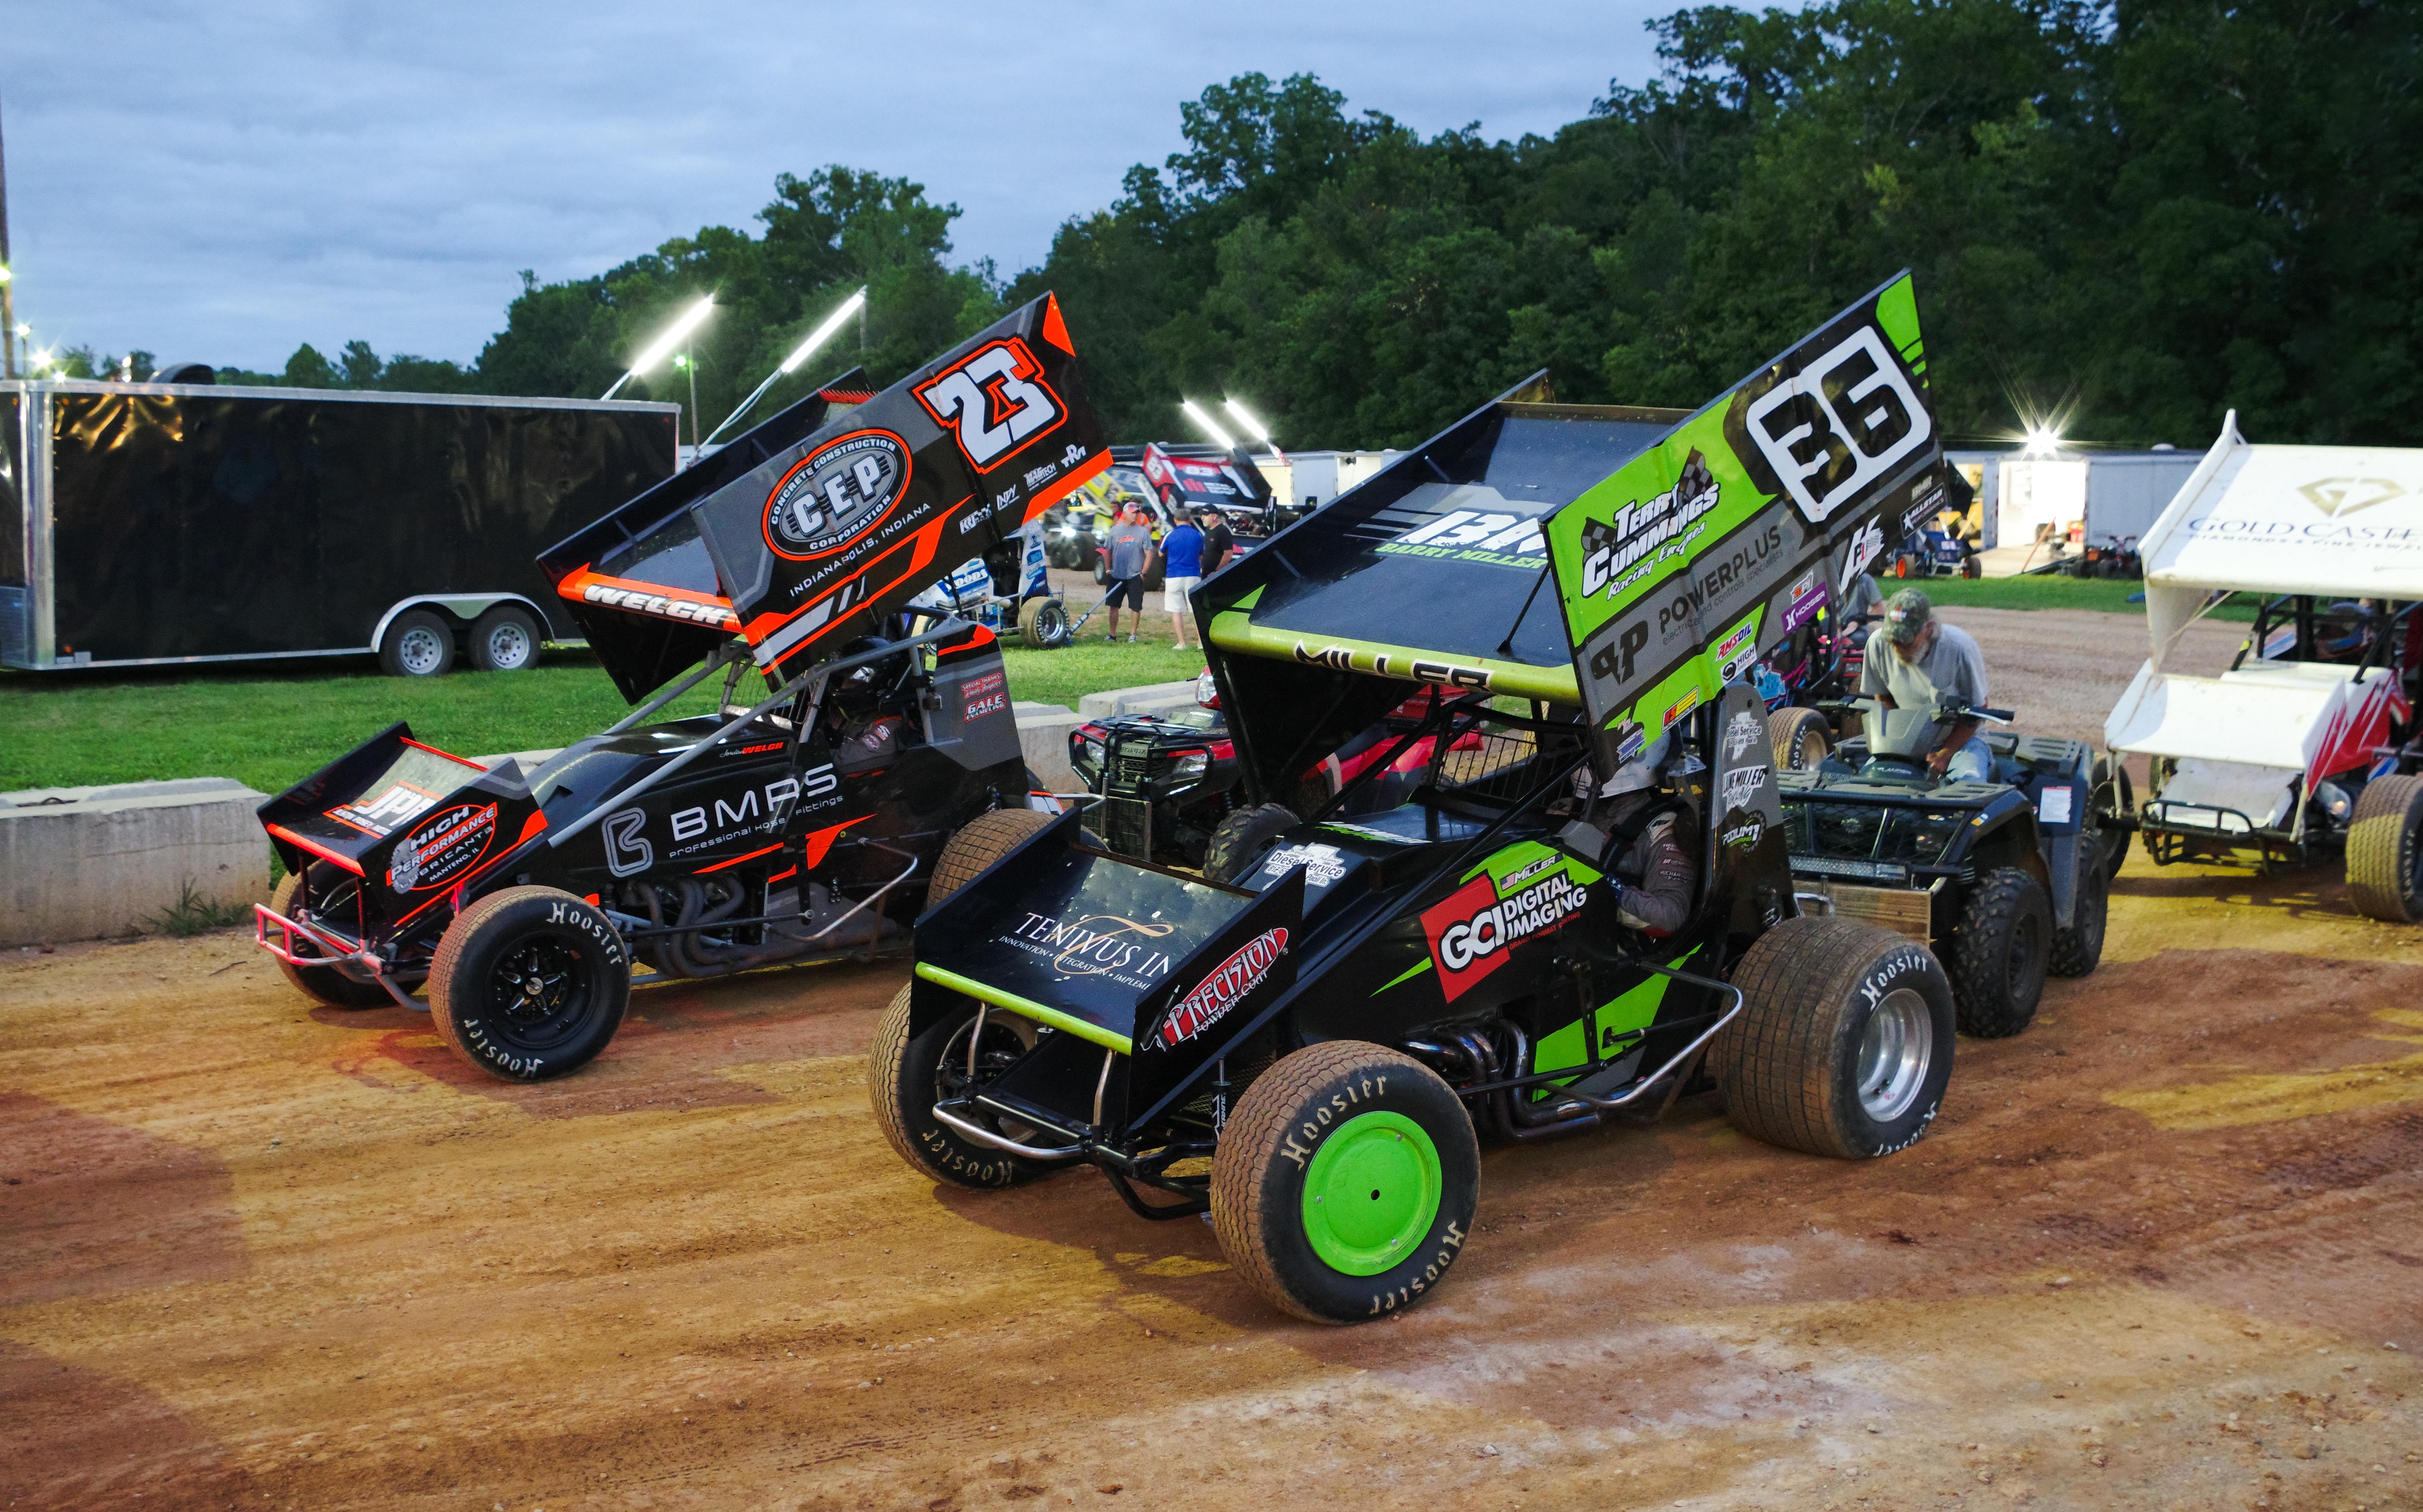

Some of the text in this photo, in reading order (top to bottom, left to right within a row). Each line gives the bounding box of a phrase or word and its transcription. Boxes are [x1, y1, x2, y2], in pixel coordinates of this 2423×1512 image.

[1752, 336, 1921, 513] 36
[771, 438, 896, 525] CONCRETE CONSTRUCTION
[792, 455, 882, 534] CEP
[809, 495, 891, 551] CORPORATION
[1615, 482, 1680, 543] TERRY
[2188, 517, 2294, 536] GOLD
[789, 539, 879, 597] INDIANAPOLIS,
[881, 503, 931, 538] INDIANA
[1373, 543, 1549, 569] BARRY MILLER
[1582, 483, 1720, 597] CUMMINGS
[1607, 521, 1706, 601] Racing Engines
[584, 585, 727, 624] WELCH
[1659, 525, 1781, 634] POWERPLUS
[1714, 579, 1744, 608] controls
[1795, 590, 1825, 618] HOOSIER
[1717, 623, 1752, 661] AMSOIL
[1737, 645, 1755, 667] HIGH
[962, 674, 1000, 689] SPECIAL THANKS
[968, 694, 1002, 714] GALE
[966, 703, 1004, 720] ENAMELING
[1740, 726, 1762, 736] Service
[742, 742, 784, 754] WELCH
[391, 806, 494, 880] PERFORMANCE
[410, 806, 470, 851] HIGH
[399, 825, 494, 888] LUBRICANTS
[1271, 852, 1343, 877] Diesel Service
[1306, 874, 1321, 883] Paoli
[1514, 856, 1556, 884] MILLER
[1503, 874, 1572, 921] DIGITAL
[1508, 887, 1587, 940] IMAGING
[546, 902, 623, 965] Hoosier
[998, 935, 1049, 958] INNOVATION
[1054, 953, 1109, 977] INTEGRATION
[1441, 906, 1505, 969] GCI
[1168, 928, 1279, 1041] PRECISION
[1192, 968, 1268, 1041] POWDER COAT
[1281, 1075, 1387, 1171] Hoosier
[1369, 1220, 1466, 1315] Hoosier
